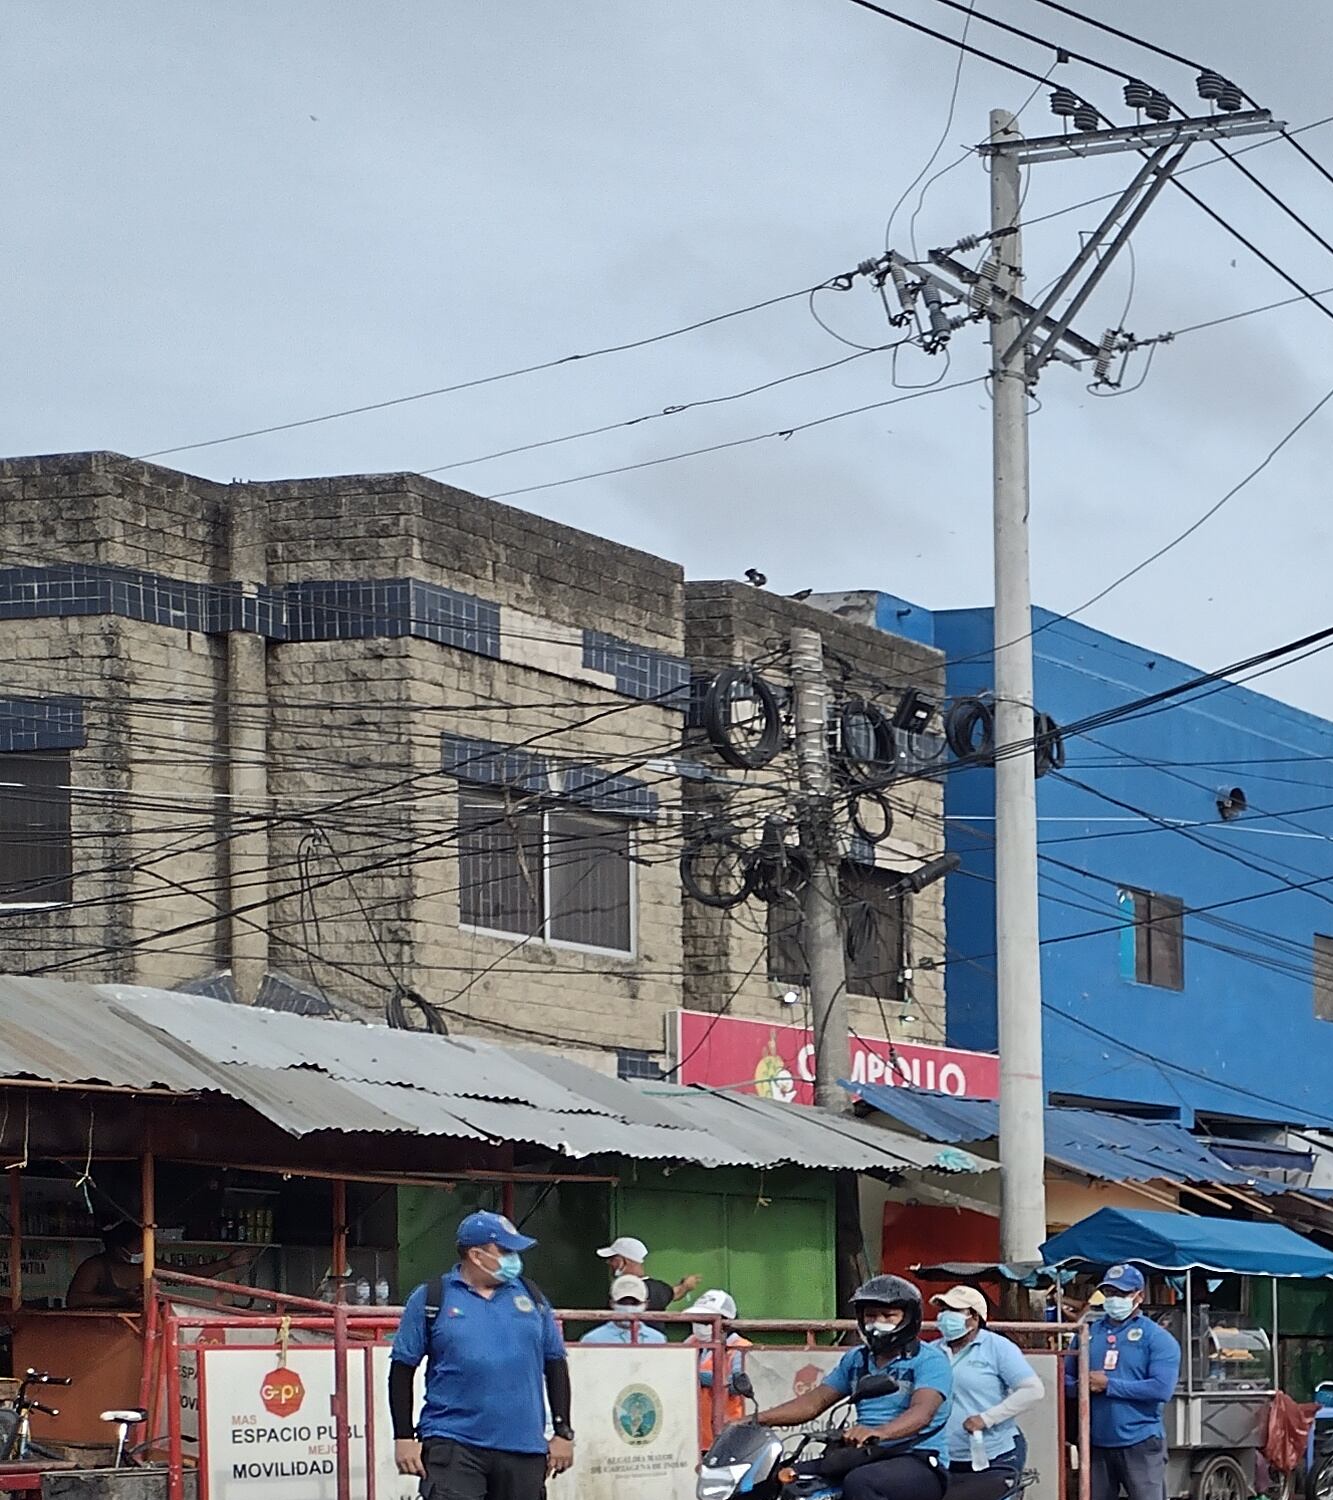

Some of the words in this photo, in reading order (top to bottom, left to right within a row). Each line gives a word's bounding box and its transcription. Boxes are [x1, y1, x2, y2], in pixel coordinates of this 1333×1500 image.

[231, 1414, 258, 1426] MAS
[231, 1426, 312, 1445] ESPACIO
[232, 1459, 335, 1480] MOVILIDAD
